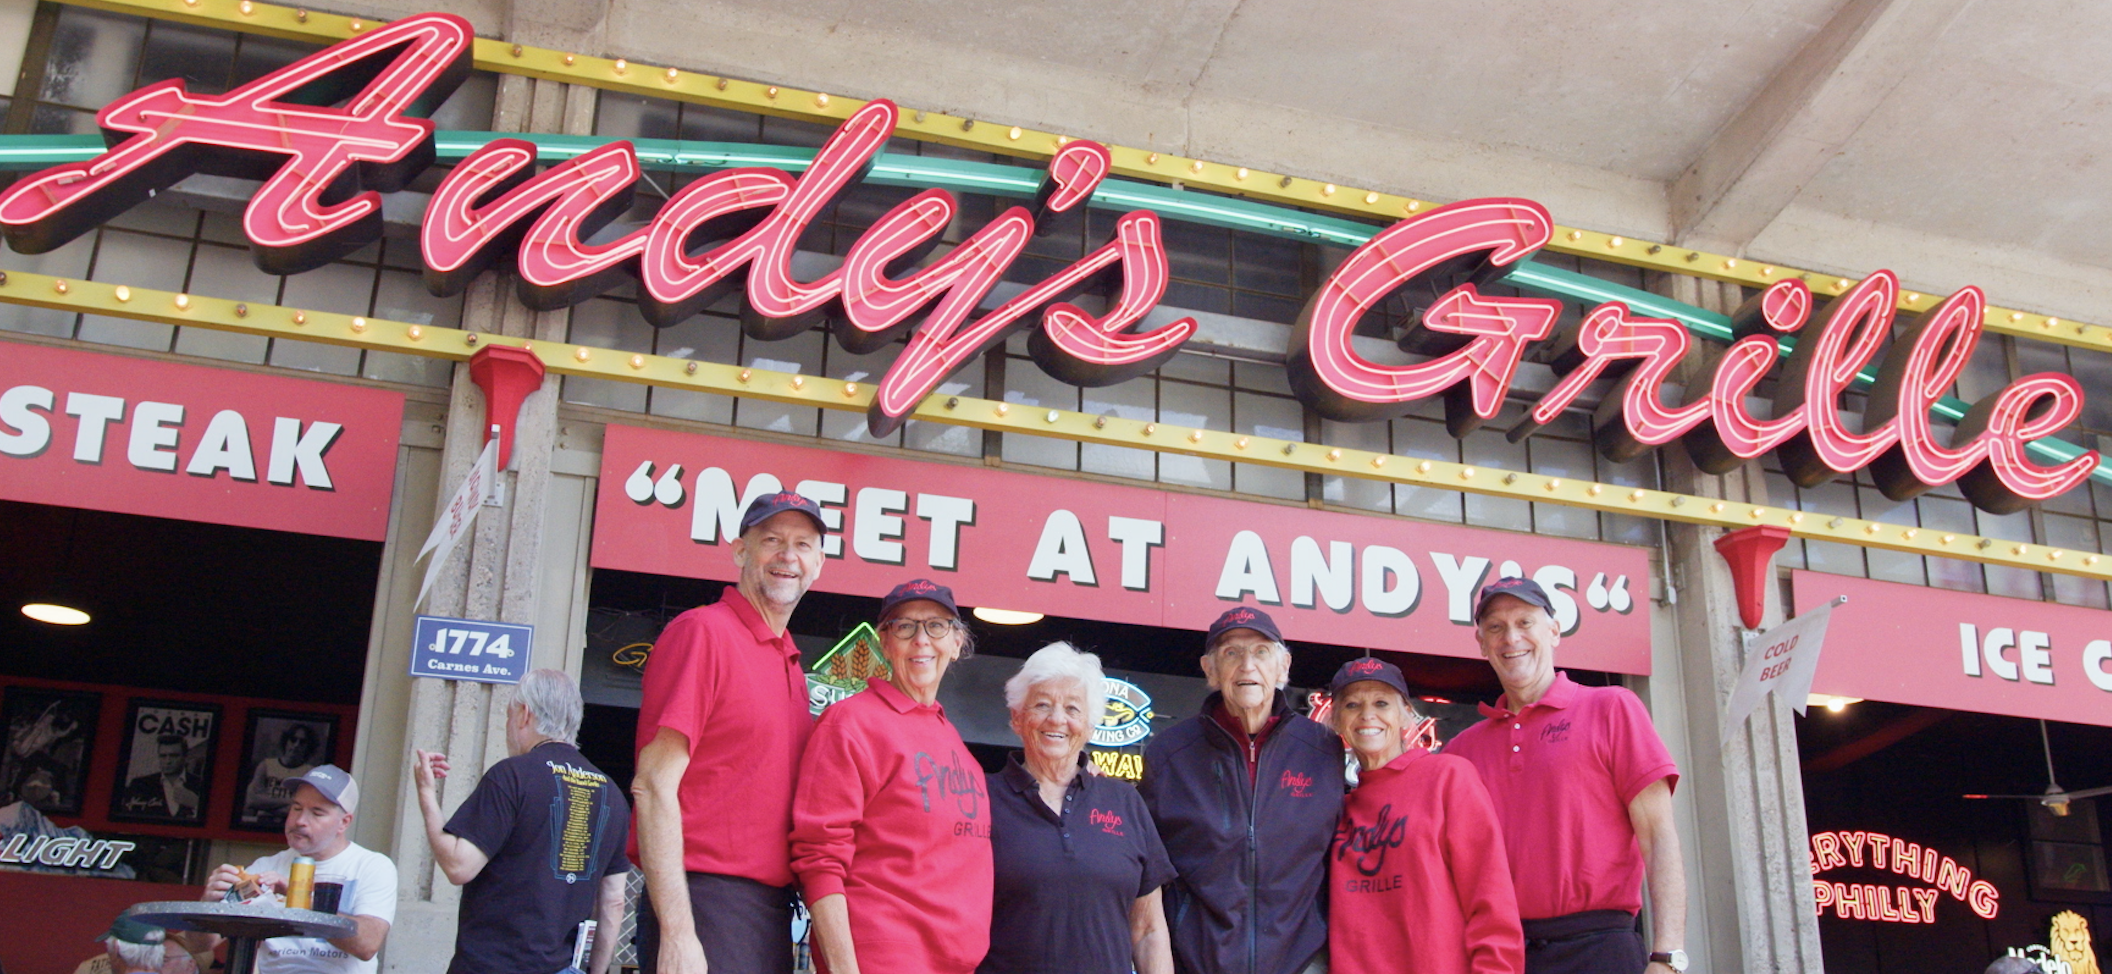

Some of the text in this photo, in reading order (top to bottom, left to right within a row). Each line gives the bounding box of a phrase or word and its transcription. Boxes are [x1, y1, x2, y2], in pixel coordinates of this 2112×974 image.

[0, 12, 2100, 500] Andy's Grille
[0, 385, 343, 488] STEAK
[1026, 509, 1162, 589] AT
[435, 628, 510, 658] 1774
[1764, 635, 1799, 660] COLD
[1960, 622, 2053, 683] ICE
[428, 659, 511, 676] Carnes Ave.
[1760, 657, 1792, 682] BEER
[138, 713, 209, 738] CASH
[0, 833, 136, 869] LIGHT
[1345, 875, 1402, 893] GRILLE
[1813, 880, 1938, 923] PHILLY
[309, 946, 349, 959] Motors
